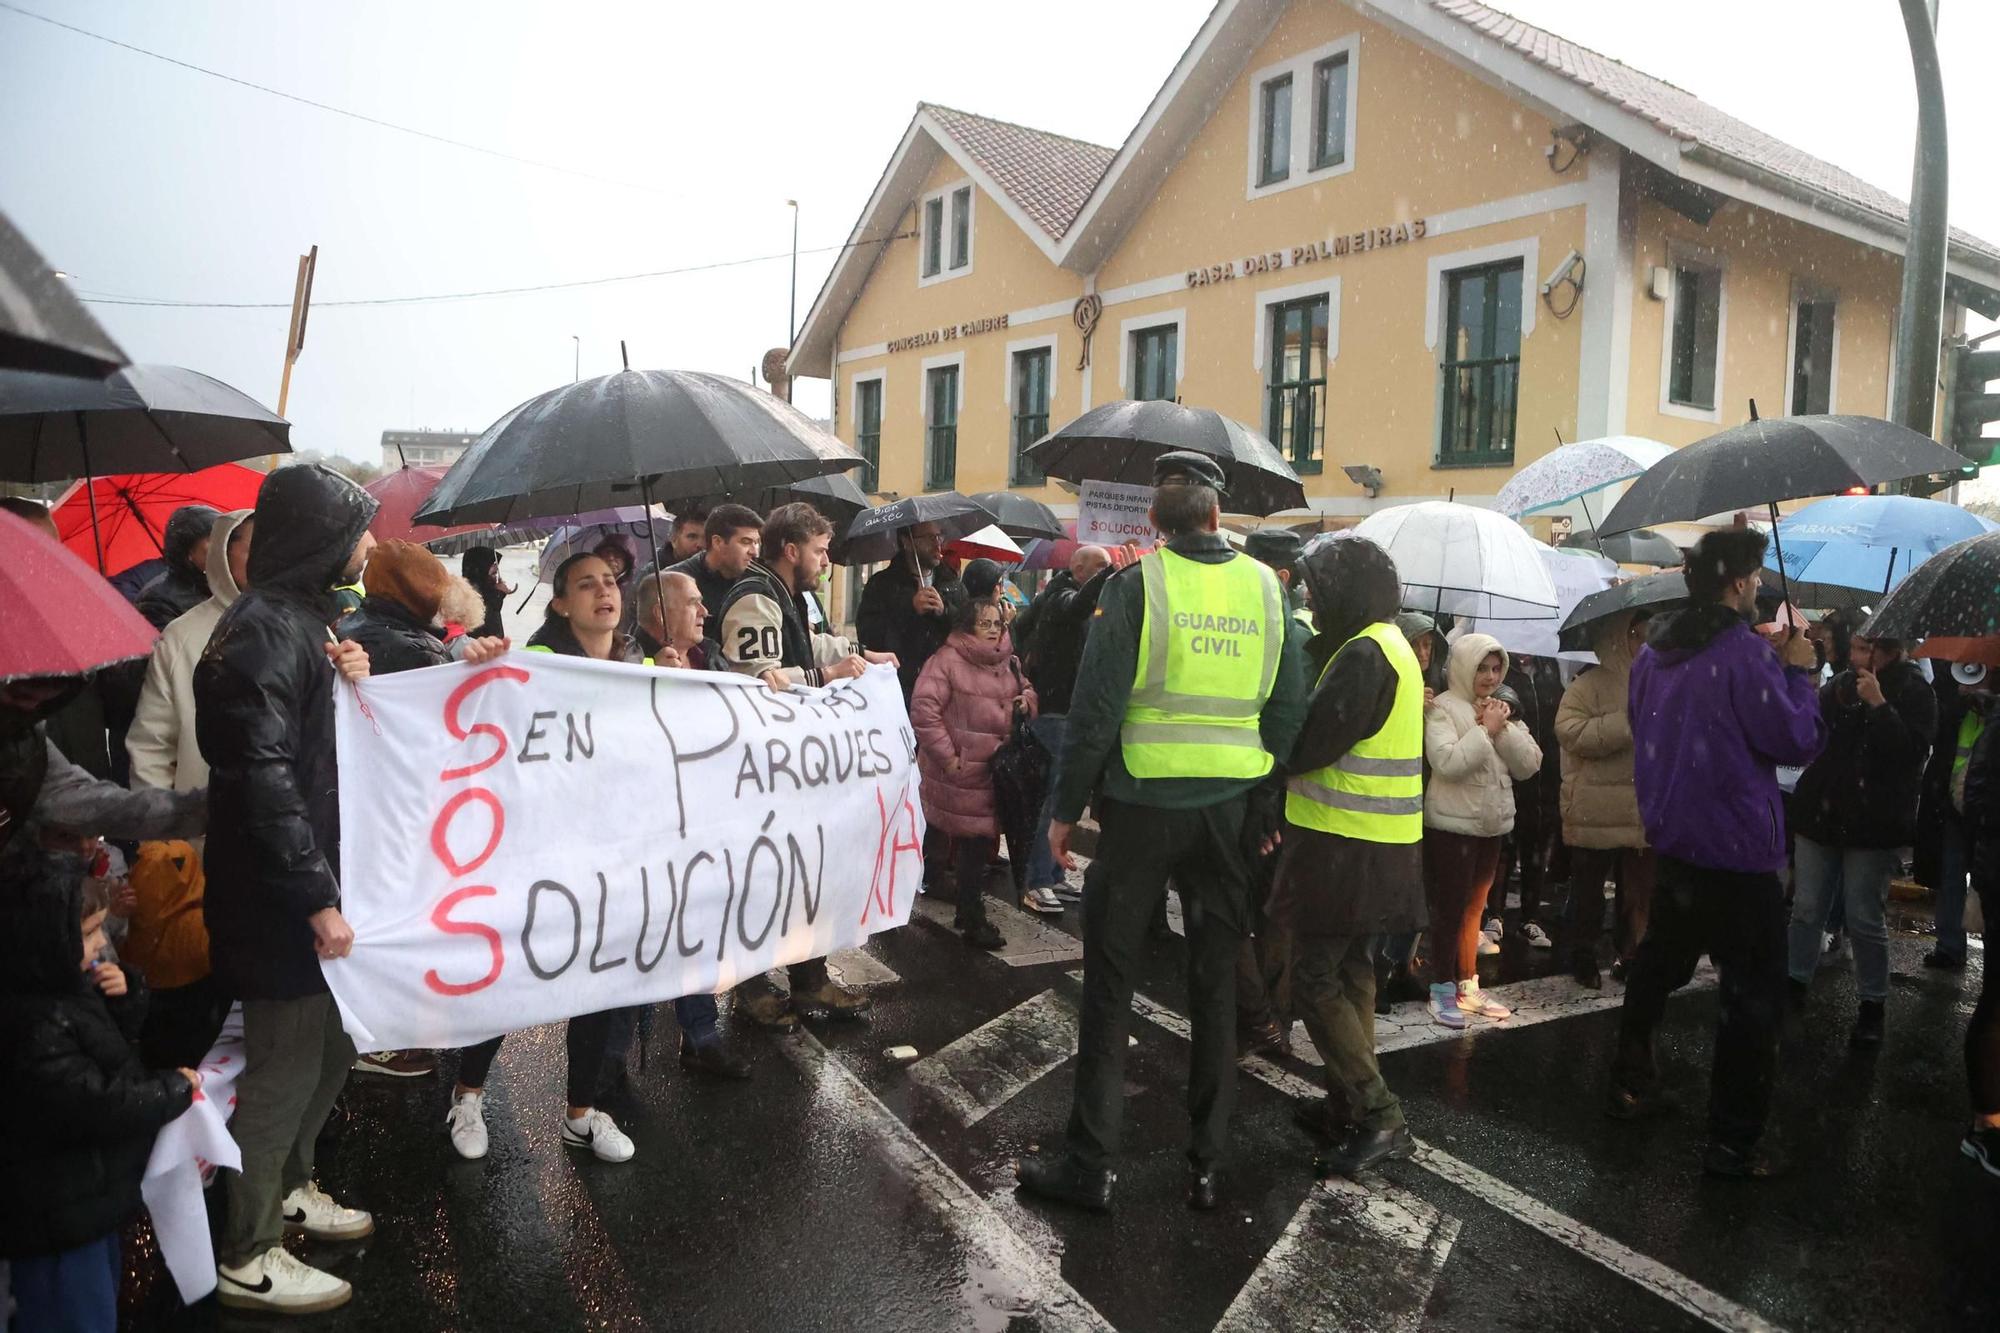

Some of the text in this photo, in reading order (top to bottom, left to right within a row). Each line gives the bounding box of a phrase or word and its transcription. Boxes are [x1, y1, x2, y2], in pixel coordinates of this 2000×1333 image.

[1185, 218, 1427, 288] CASA DAS PALMEIRAS
[887, 313, 1009, 353] CONCELLO DE CAMBRE
[1086, 501, 1112, 510] PISTAS
[1088, 490, 1152, 504] PARQUES INFANT
[1174, 612, 1260, 636] GUARDIA
[738, 626, 780, 660] 20
[1190, 636, 1242, 657] CIVIL
